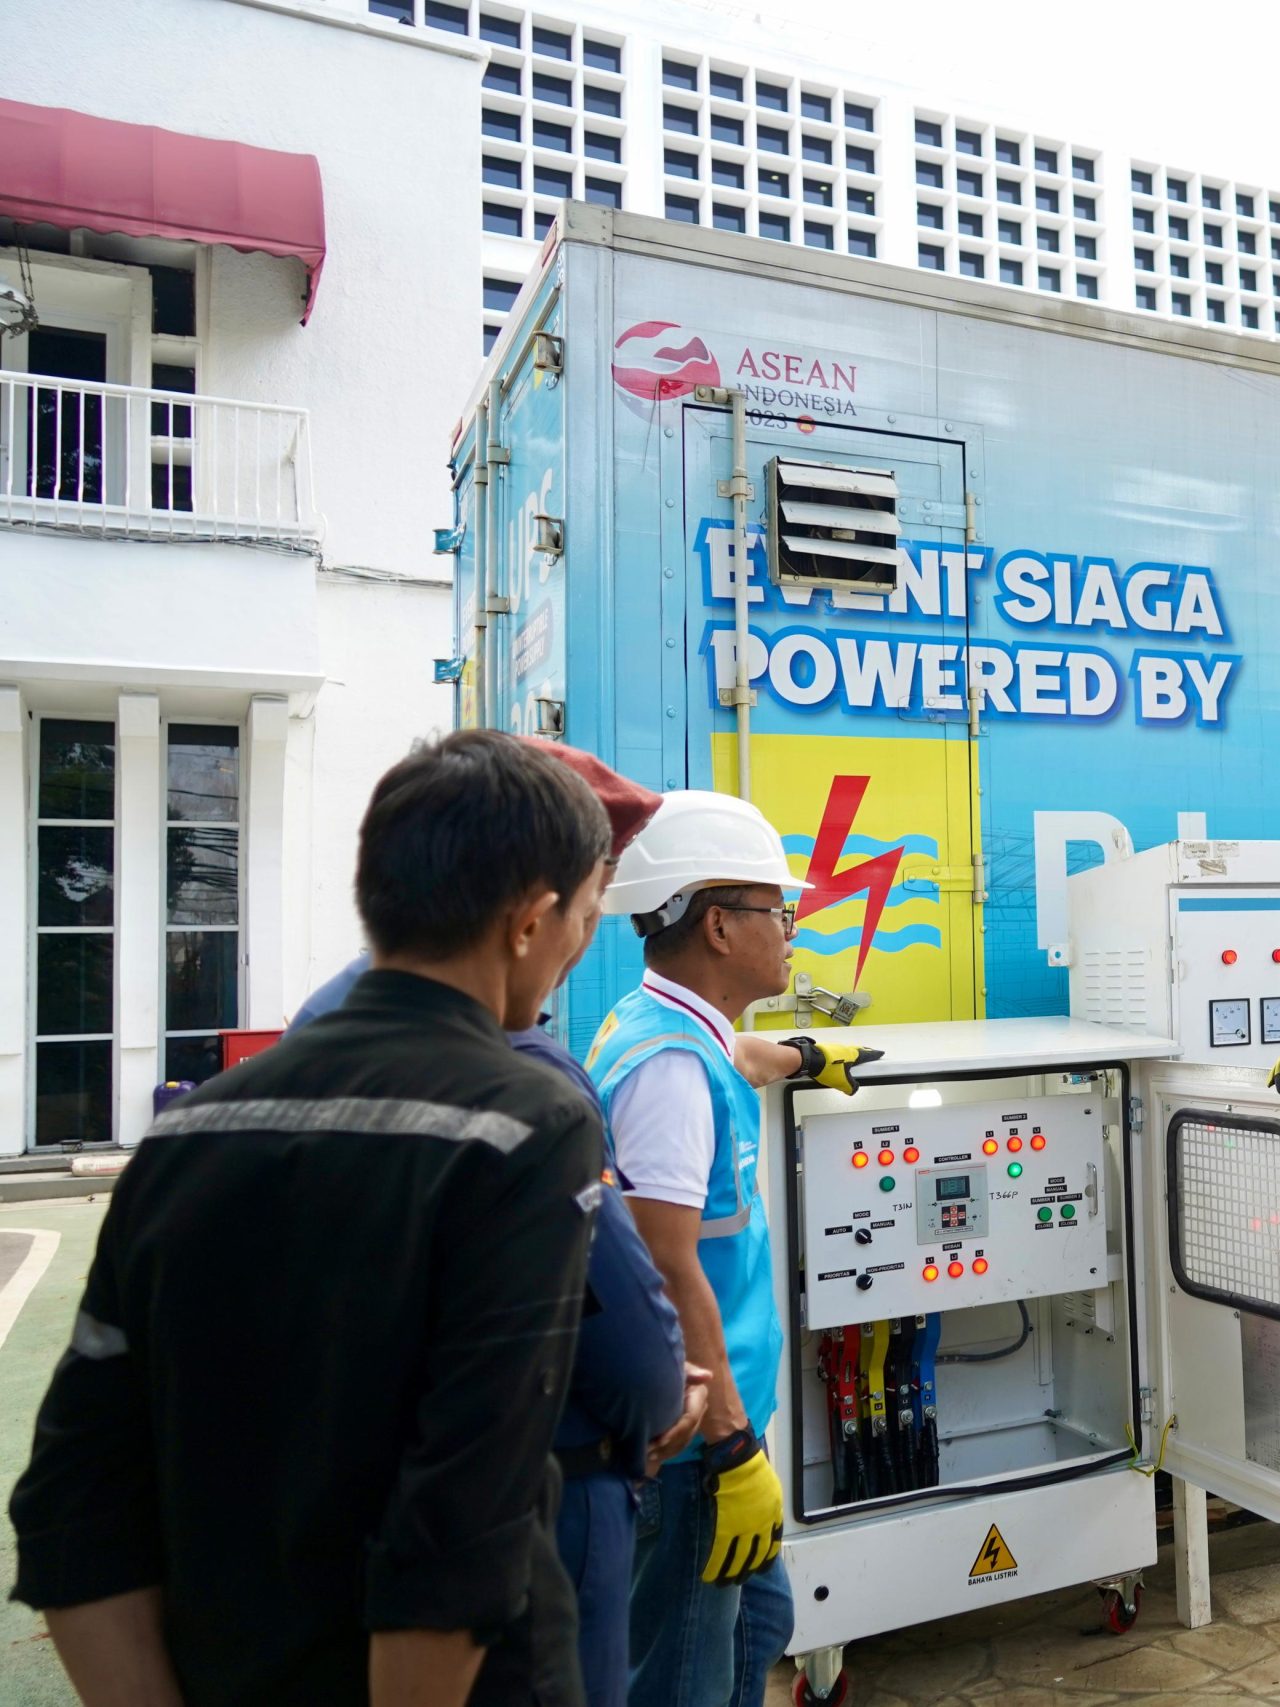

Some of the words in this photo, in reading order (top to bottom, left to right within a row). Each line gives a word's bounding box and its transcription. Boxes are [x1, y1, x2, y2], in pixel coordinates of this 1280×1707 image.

[736, 347, 858, 393] ASEAN
[743, 407, 788, 430] 023
[704, 527, 985, 617] ENT
[1002, 556, 1224, 636] SIAGA
[709, 629, 1118, 716] POWERED
[1136, 656, 1233, 721] BY
[938, 1154, 969, 1163] CONTROLLER
[823, 1270, 850, 1279] PRIORITAS
[967, 1575, 993, 1586] BAHAYA
[994, 1569, 1019, 1581] LISTRIK
